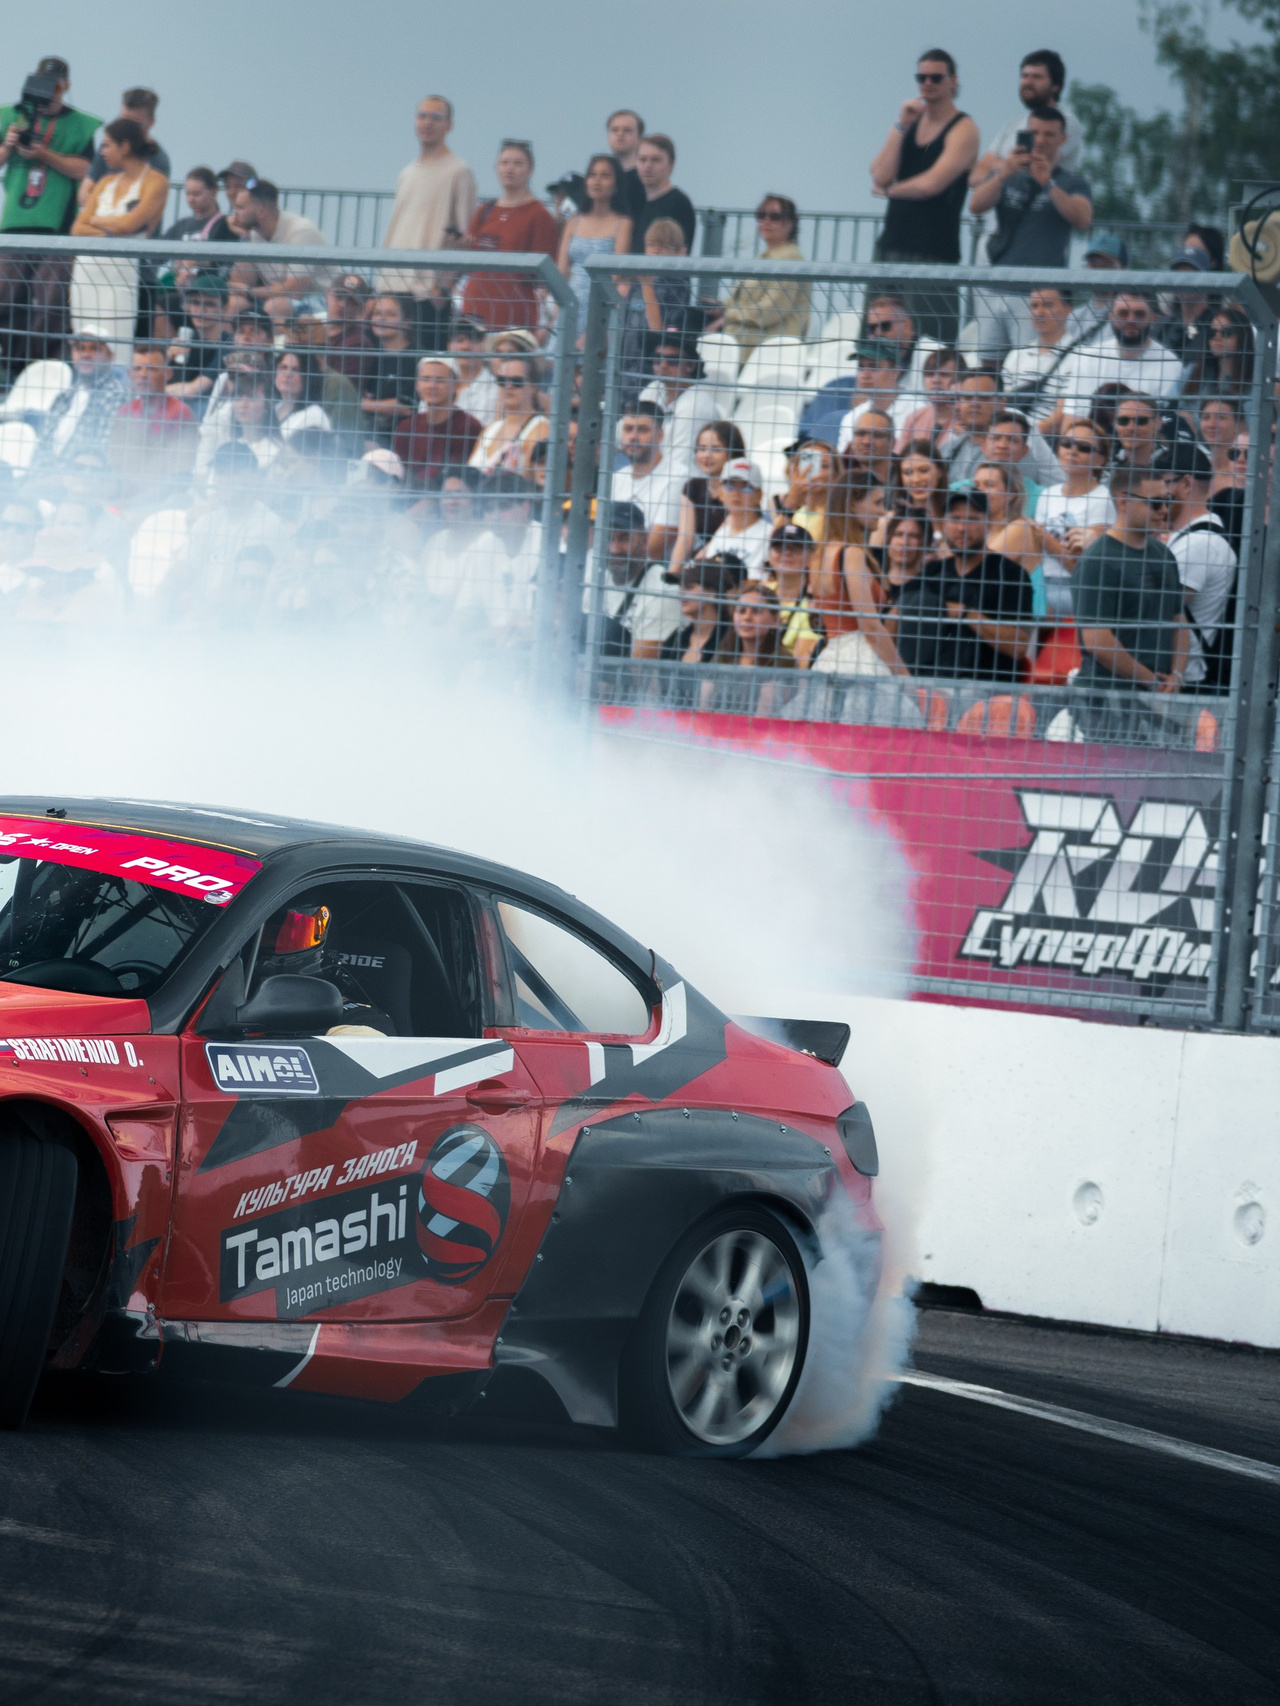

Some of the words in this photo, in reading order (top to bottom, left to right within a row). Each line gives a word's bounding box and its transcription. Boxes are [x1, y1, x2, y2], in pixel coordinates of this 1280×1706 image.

[48, 842, 99, 856] OPEN
[119, 856, 234, 891] PRO
[961, 911, 1215, 980] СуперФи
[6, 1038, 121, 1066] SERAFIMENKO
[217, 1054, 314, 1084] AIMOL
[232, 1164, 335, 1219] КУЛЬТУРА
[336, 1139, 419, 1186] ЗАНОСА
[225, 1184, 408, 1289] Tamashi
[286, 1279, 324, 1310] Japan
[325, 1256, 403, 1297] technology
